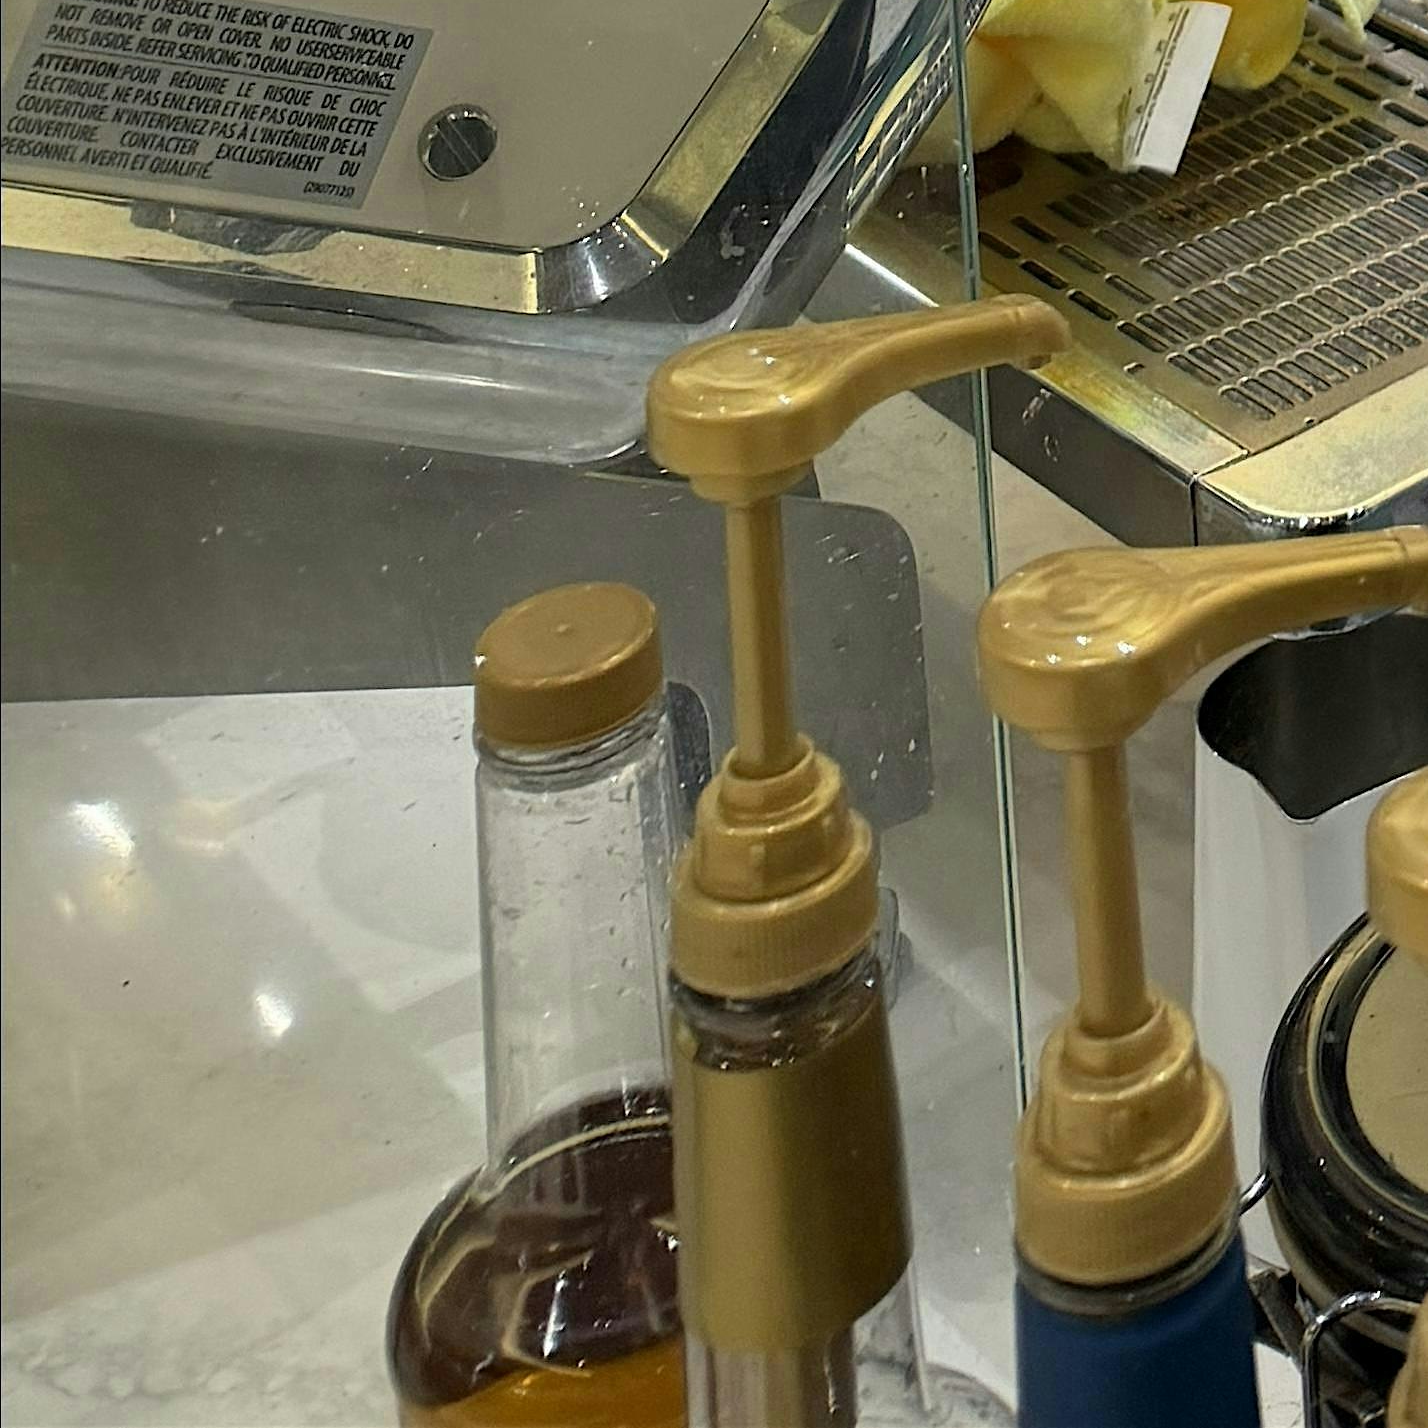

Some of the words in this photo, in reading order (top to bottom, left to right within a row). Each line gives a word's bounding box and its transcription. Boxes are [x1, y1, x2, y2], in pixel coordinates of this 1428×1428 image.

[56, 4, 86, 20] NOT
[90, 8, 147, 31] REMOVE
[152, 17, 172, 35] OR
[177, 21, 214, 41] OPEN
[270, 36, 292, 52] NO
[296, 39, 406, 69] USERSERVICEABLE
[217, 5, 240, 23] THE
[241, 9, 273, 27] RISK
[273, 14, 290, 30] OF
[291, 17, 349, 39] ELECTRIC
[394, 33, 414, 49] DO
[46, 25, 89, 44] PARTS
[137, 36, 177, 58] REFER
[178, 43, 240, 66] SERVICING
[246, 52, 260, 69] TO
[261, 56, 324, 80] QUALIFIED
[112, 86, 134, 102] NE
[135, 90, 161, 107] PAS
[161, 94, 221, 115] ENLEVER
[221, 101, 240, 116] ET
[241, 104, 260, 120] NE
[260, 107, 287, 125] PAS
[287, 112, 338, 132] OUVRIR
[338, 118, 378, 138] CETTE
[169, 71, 229, 94] RÉDUIRE
[237, 82, 256, 97] LE
[264, 85, 314, 106] RISQUE
[321, 94, 341, 110] DE
[349, 98, 387, 117] CHOC
[1, 136, 78, 162] PERSONNEL
[84, 148, 132, 169] AVERTI
[130, 155, 151, 171] ET
[112, 107, 209, 136] N'INTERVENEZ
[210, 121, 235, 140] PAS
[237, 122, 247, 141] À
[250, 126, 332, 153] L'INTÉRIEUR
[330, 137, 351, 155] DE
[351, 140, 367, 157] LA
[120, 130, 200, 156] CONTACTER
[215, 143, 324, 172] EXCLUSIVEMENT
[339, 160, 361, 177] DU
